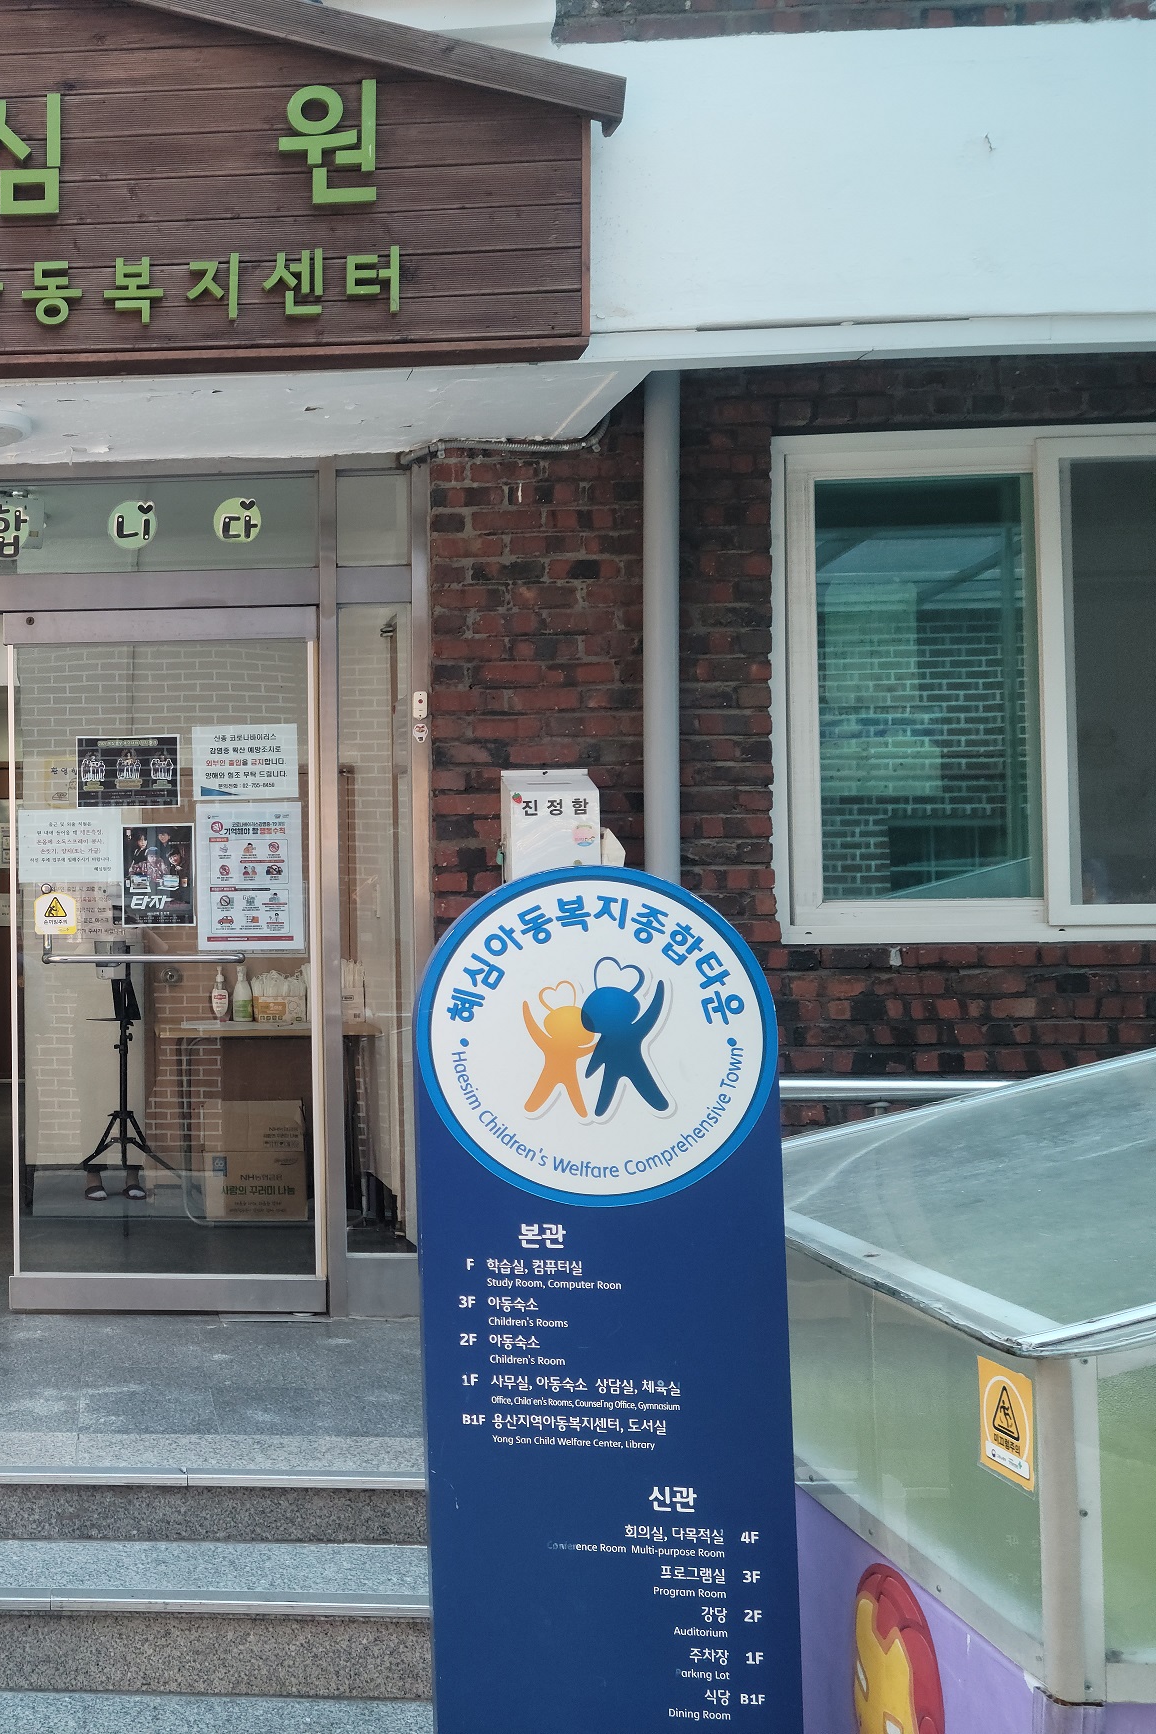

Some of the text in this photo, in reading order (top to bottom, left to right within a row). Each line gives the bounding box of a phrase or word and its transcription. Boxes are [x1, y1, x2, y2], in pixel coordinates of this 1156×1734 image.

[214, 734, 277, 742] 신종 코로나바이러스
[206, 759, 226, 767] 외부인
[250, 758, 286, 766] 금지합니다.
[522, 798, 589, 816] 진정함
[130, 895, 175, 910] 타자
[446, 894, 745, 1026] 혜심아동복지종합타운
[451, 1046, 745, 1179] Haesim Children's Welfare Comprehensive Town
[222, 1185, 296, 1196] 사랑의 꾸러미 나눔
[518, 1223, 566, 1249] 본관
[486, 1258, 528, 1274] 학습실,
[532, 1259, 583, 1276] 컴퓨터실
[486, 1278, 514, 1290] Study
[516, 1278, 546, 1289] Room,
[548, 1280, 595, 1290] Computer
[458, 1296, 539, 1312] 3F 아동숙소
[488, 1316, 569, 1328] Children's Rooms
[459, 1333, 541, 1350] 2F 아동숙소
[489, 1354, 566, 1366] Children's Room
[462, 1374, 682, 1397] 1F 사무실, 아동숙소 상담실, 체육실
[491, 1396, 514, 1406] Office,
[548, 1398, 574, 1408] Rooms,
[614, 1400, 637, 1410] Office,
[638, 1402, 681, 1412] Gymnasium
[462, 1413, 667, 1436] B1F 용산지역아동복지센터, 도서실
[492, 1434, 656, 1450] Yong San Child Welfare Center, Library
[994, 1432, 1021, 1456] 미끄럼주의
[648, 1486, 698, 1512] 신관
[624, 1524, 760, 1546] 회의실, 다목적실 4F
[600, 1543, 626, 1554] Room
[631, 1544, 696, 1558] Multi-purpose
[698, 1547, 726, 1558] Room
[660, 1565, 762, 1585] 프로그램실 3F
[653, 1586, 727, 1599] Program Room
[701, 1606, 763, 1624] 강당 2F
[673, 1626, 728, 1638] Auditorium
[689, 1647, 764, 1666] 주차장 1F
[715, 1670, 730, 1680] Lot
[704, 1689, 766, 1706] 식당 B1F
[668, 1708, 732, 1722] Dining Room
